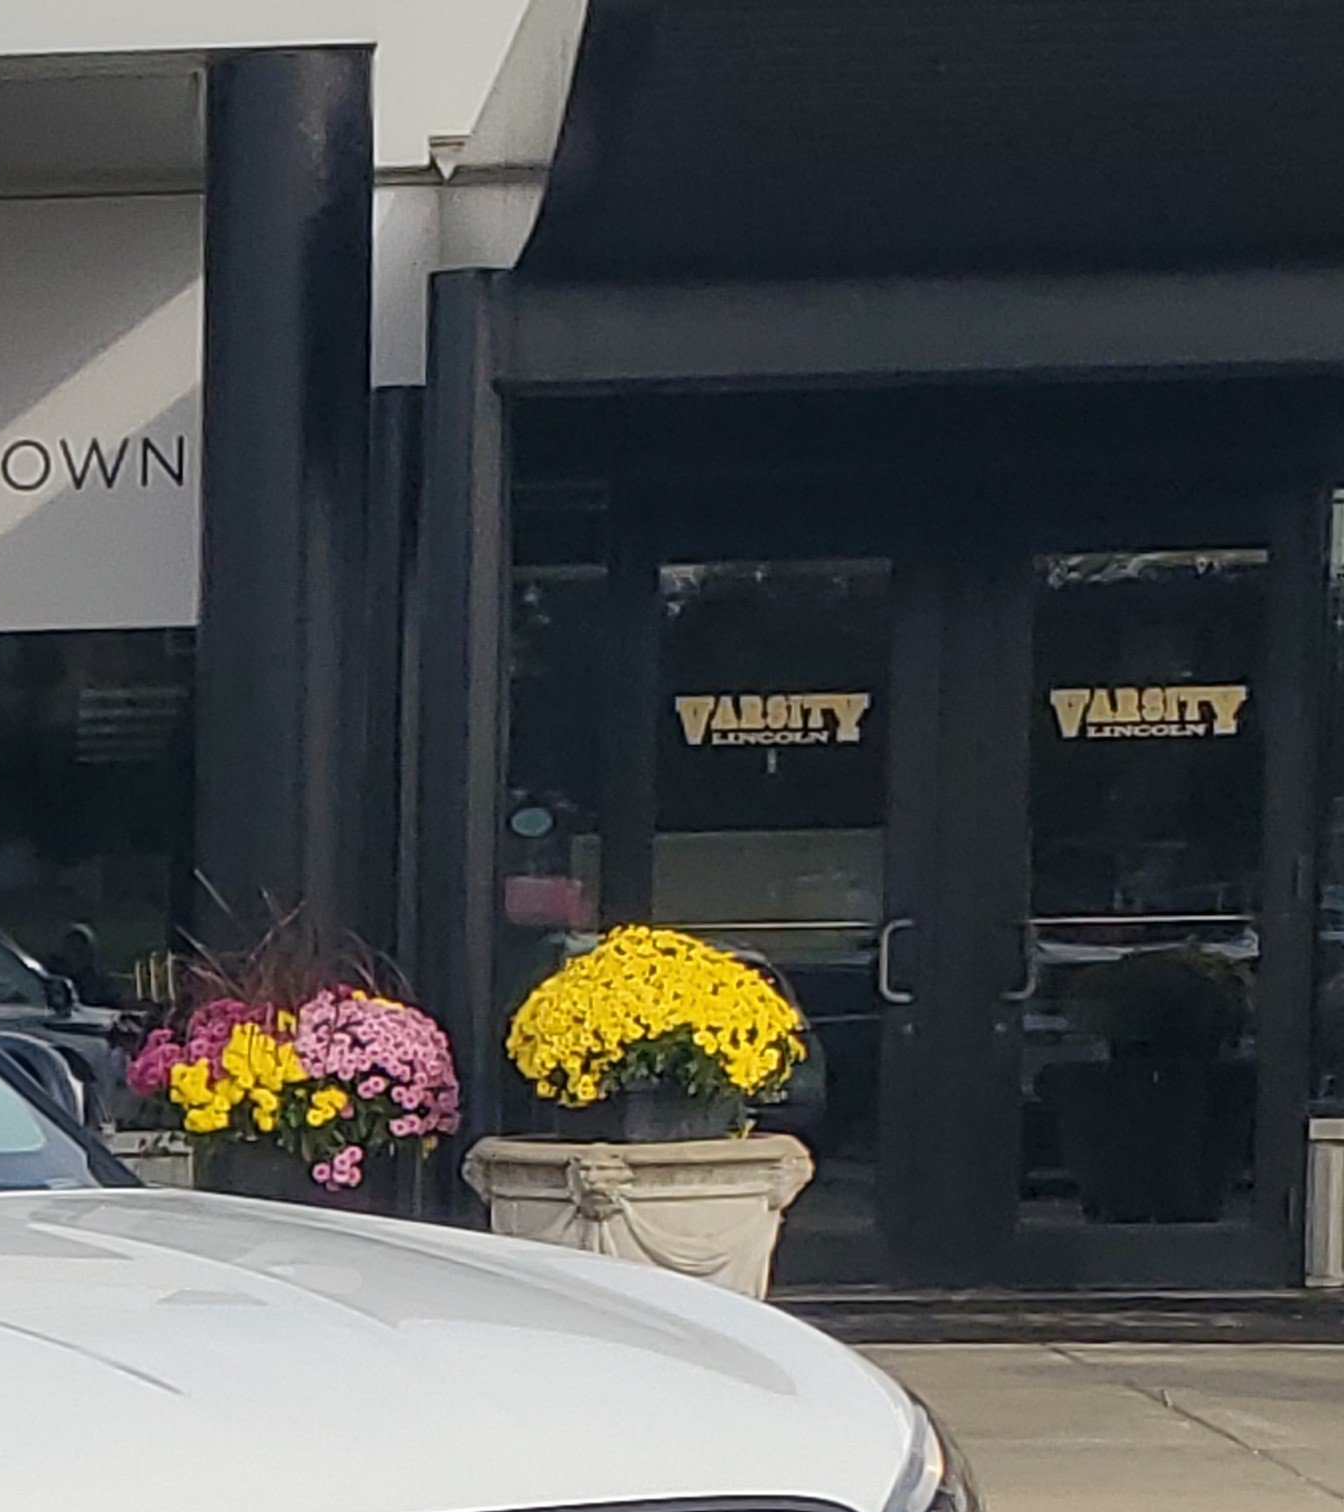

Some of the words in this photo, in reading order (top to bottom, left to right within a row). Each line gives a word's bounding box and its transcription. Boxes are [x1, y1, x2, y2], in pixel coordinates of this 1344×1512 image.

[675, 693, 869, 746] VARSITY
[1050, 685, 1247, 739] VARSITY
[711, 730, 830, 746] LINCOLN
[1086, 723, 1209, 739] LINCOLN
